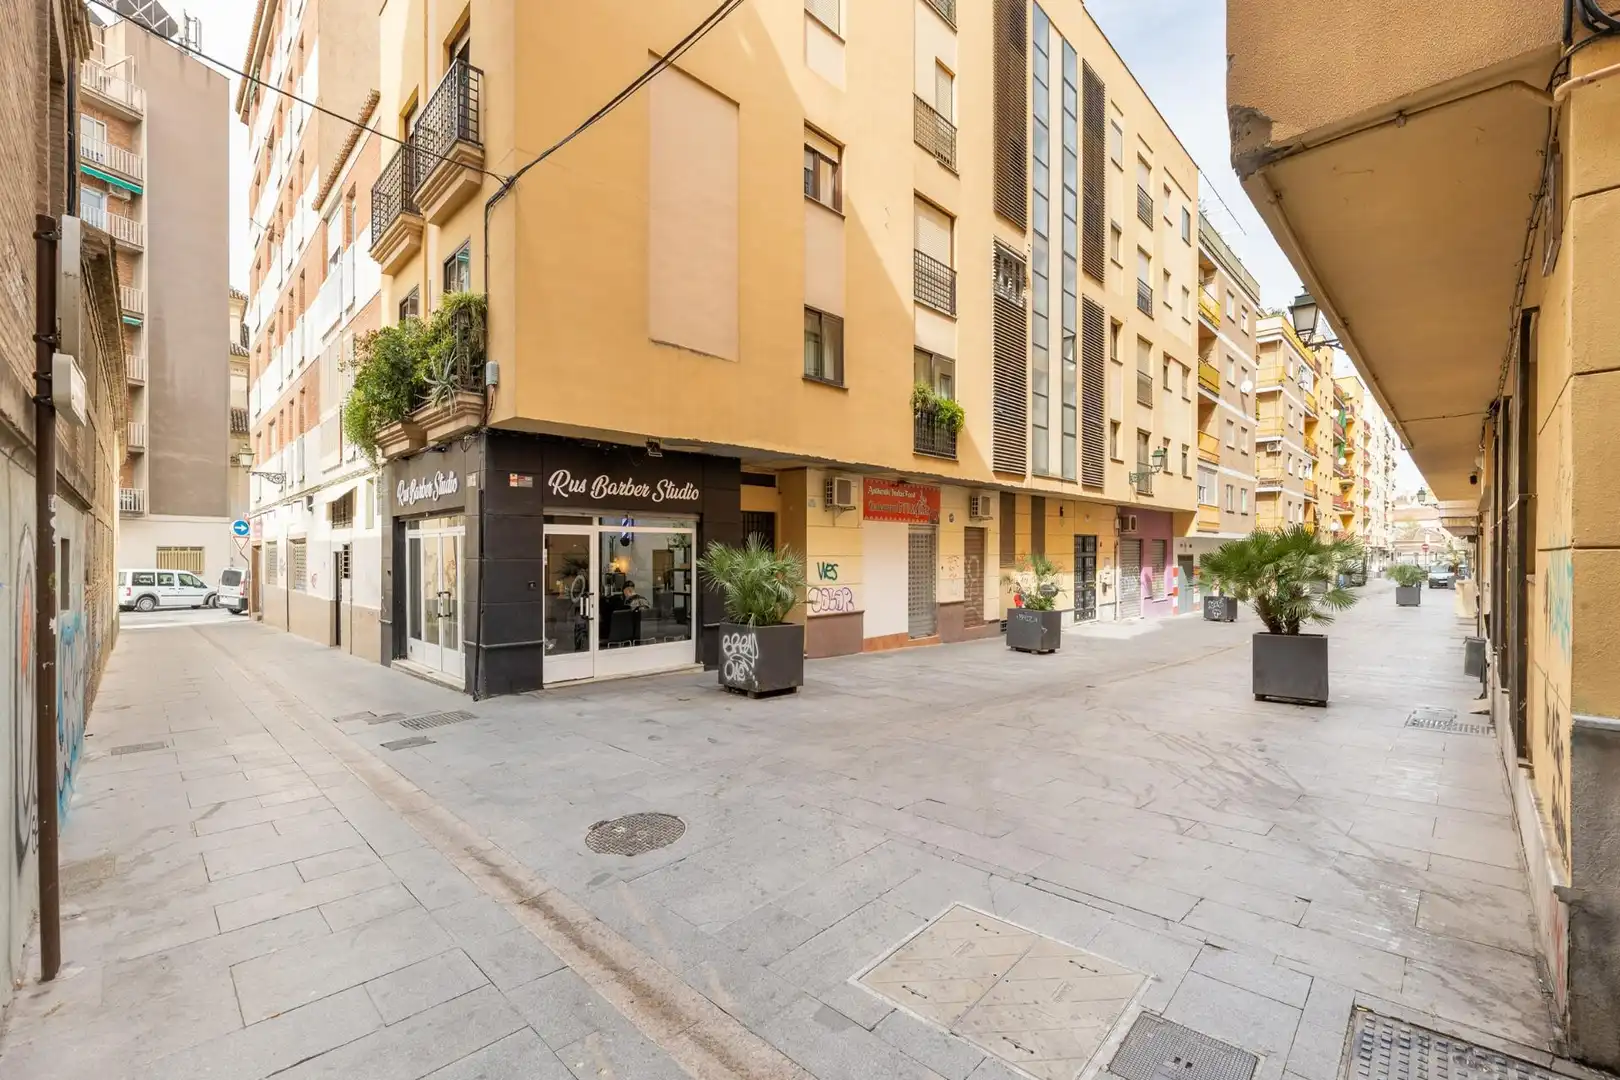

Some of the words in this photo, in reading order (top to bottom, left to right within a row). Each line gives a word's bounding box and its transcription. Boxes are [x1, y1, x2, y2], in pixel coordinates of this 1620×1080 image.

[432, 469, 458, 501] Studio
[548, 469, 587, 497] Rus
[590, 474, 650, 499] Barber
[652, 478, 699, 502] Studio
